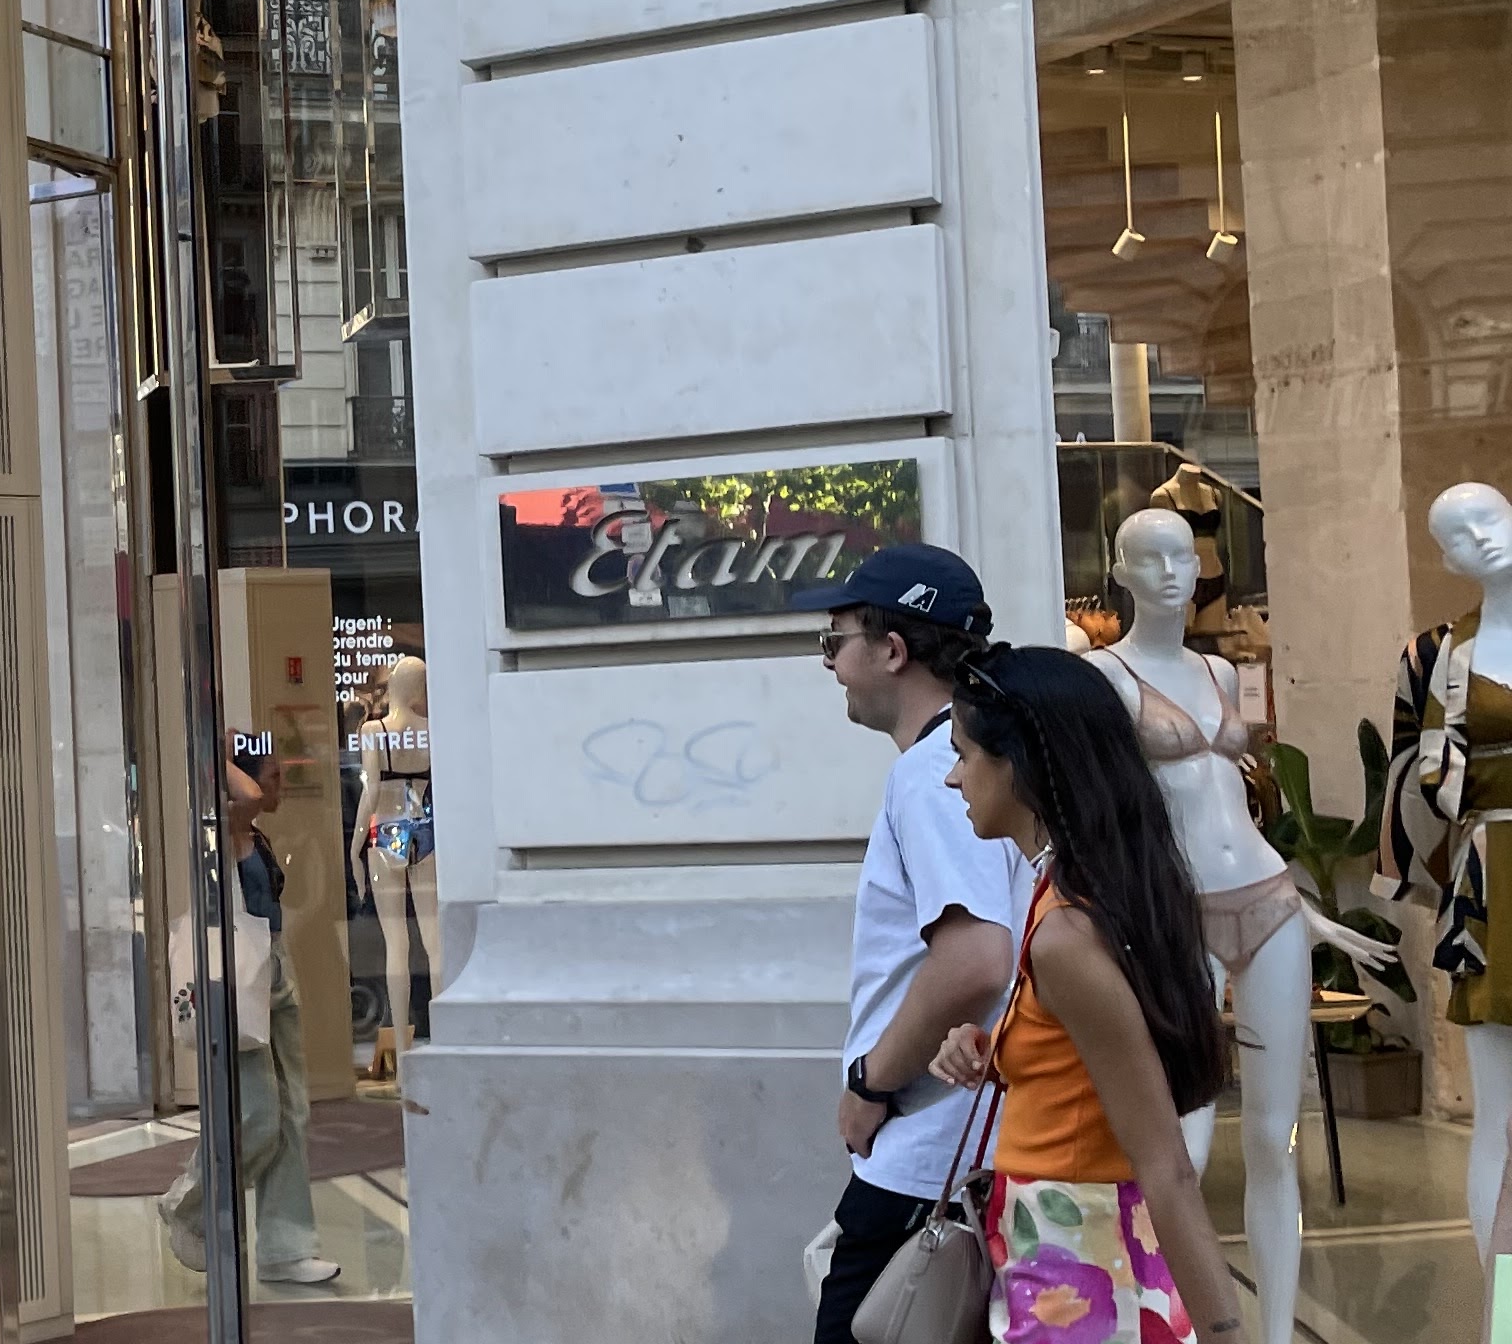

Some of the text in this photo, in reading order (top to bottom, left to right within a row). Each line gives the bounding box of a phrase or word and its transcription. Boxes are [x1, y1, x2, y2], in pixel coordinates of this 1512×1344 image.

[283, 500, 420, 534] PHOR
[570, 508, 847, 597] Etam
[233, 731, 273, 756] Pull
[347, 726, 429, 752] ENTRÉE
